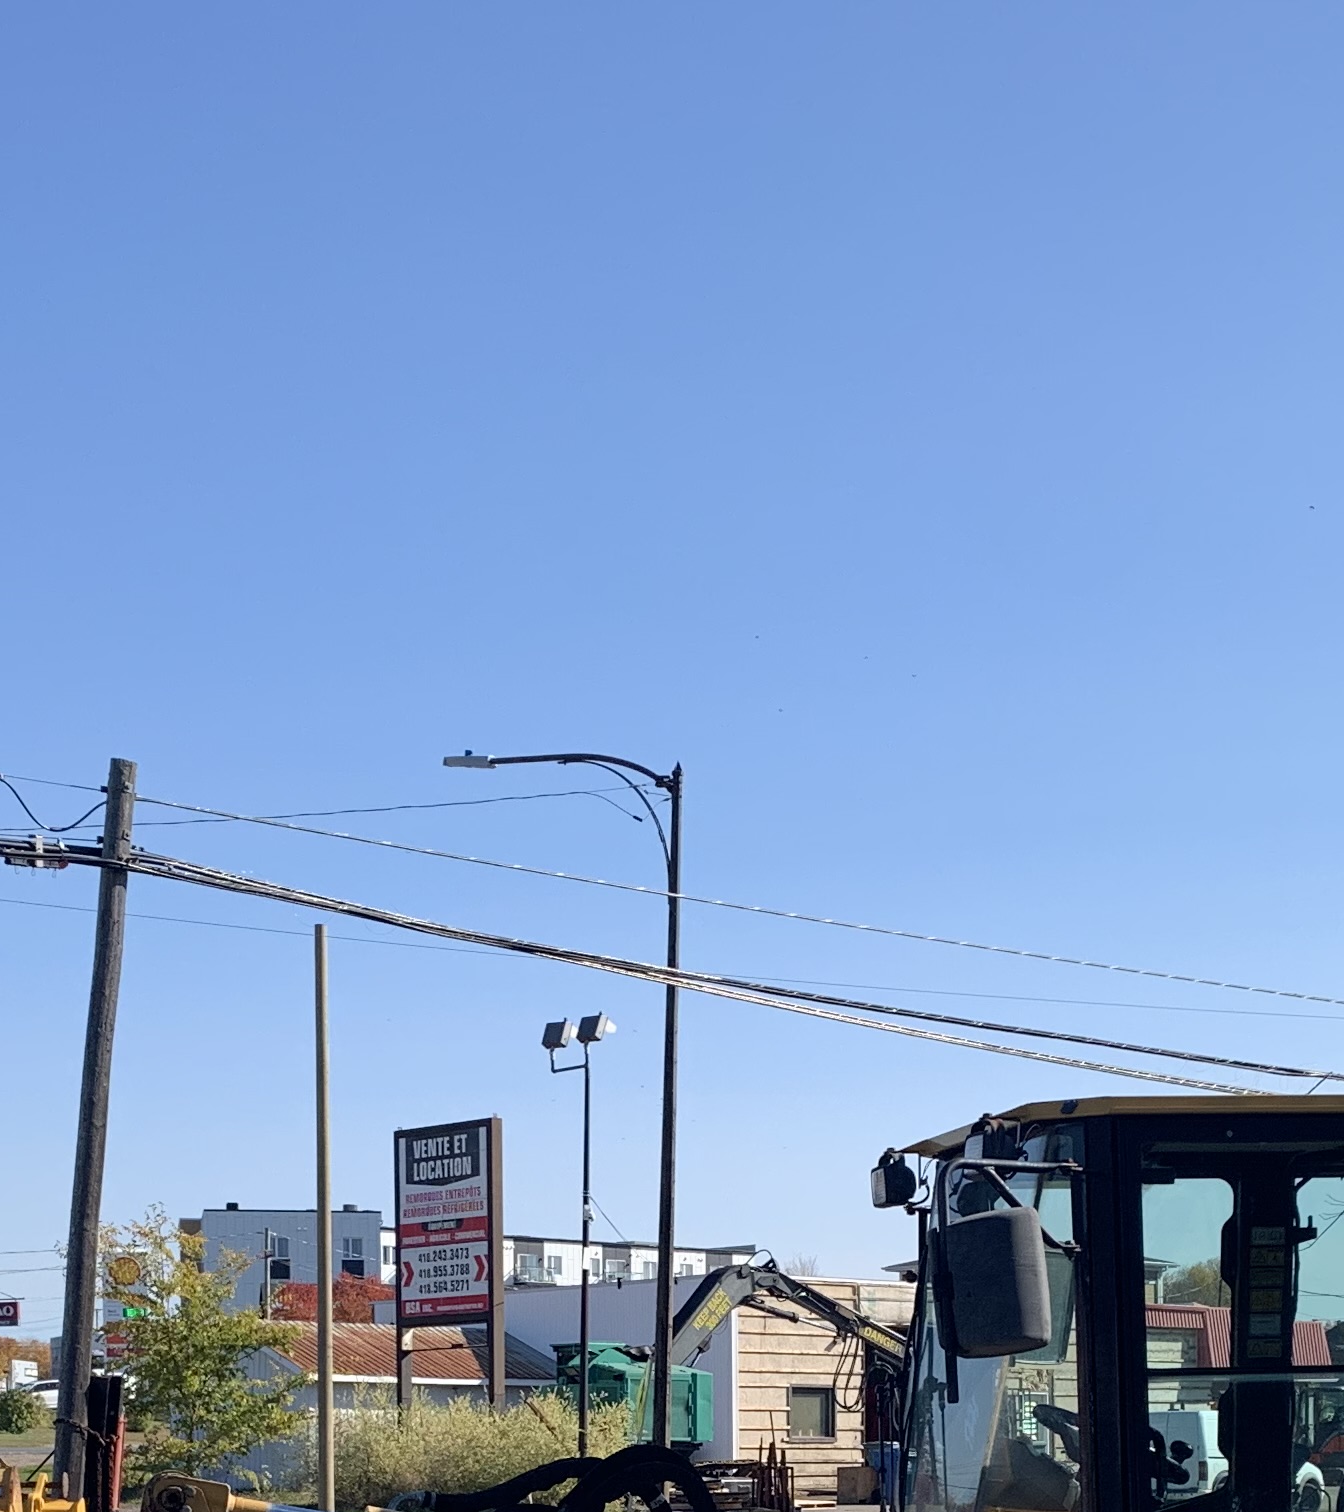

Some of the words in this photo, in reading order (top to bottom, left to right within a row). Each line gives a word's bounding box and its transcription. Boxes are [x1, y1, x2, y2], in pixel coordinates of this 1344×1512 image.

[413, 1136, 450, 1159] VENTE
[453, 1133, 468, 1154] ET
[413, 1156, 472, 1181] LOCATION
[863, 1327, 903, 1354] DANGER
